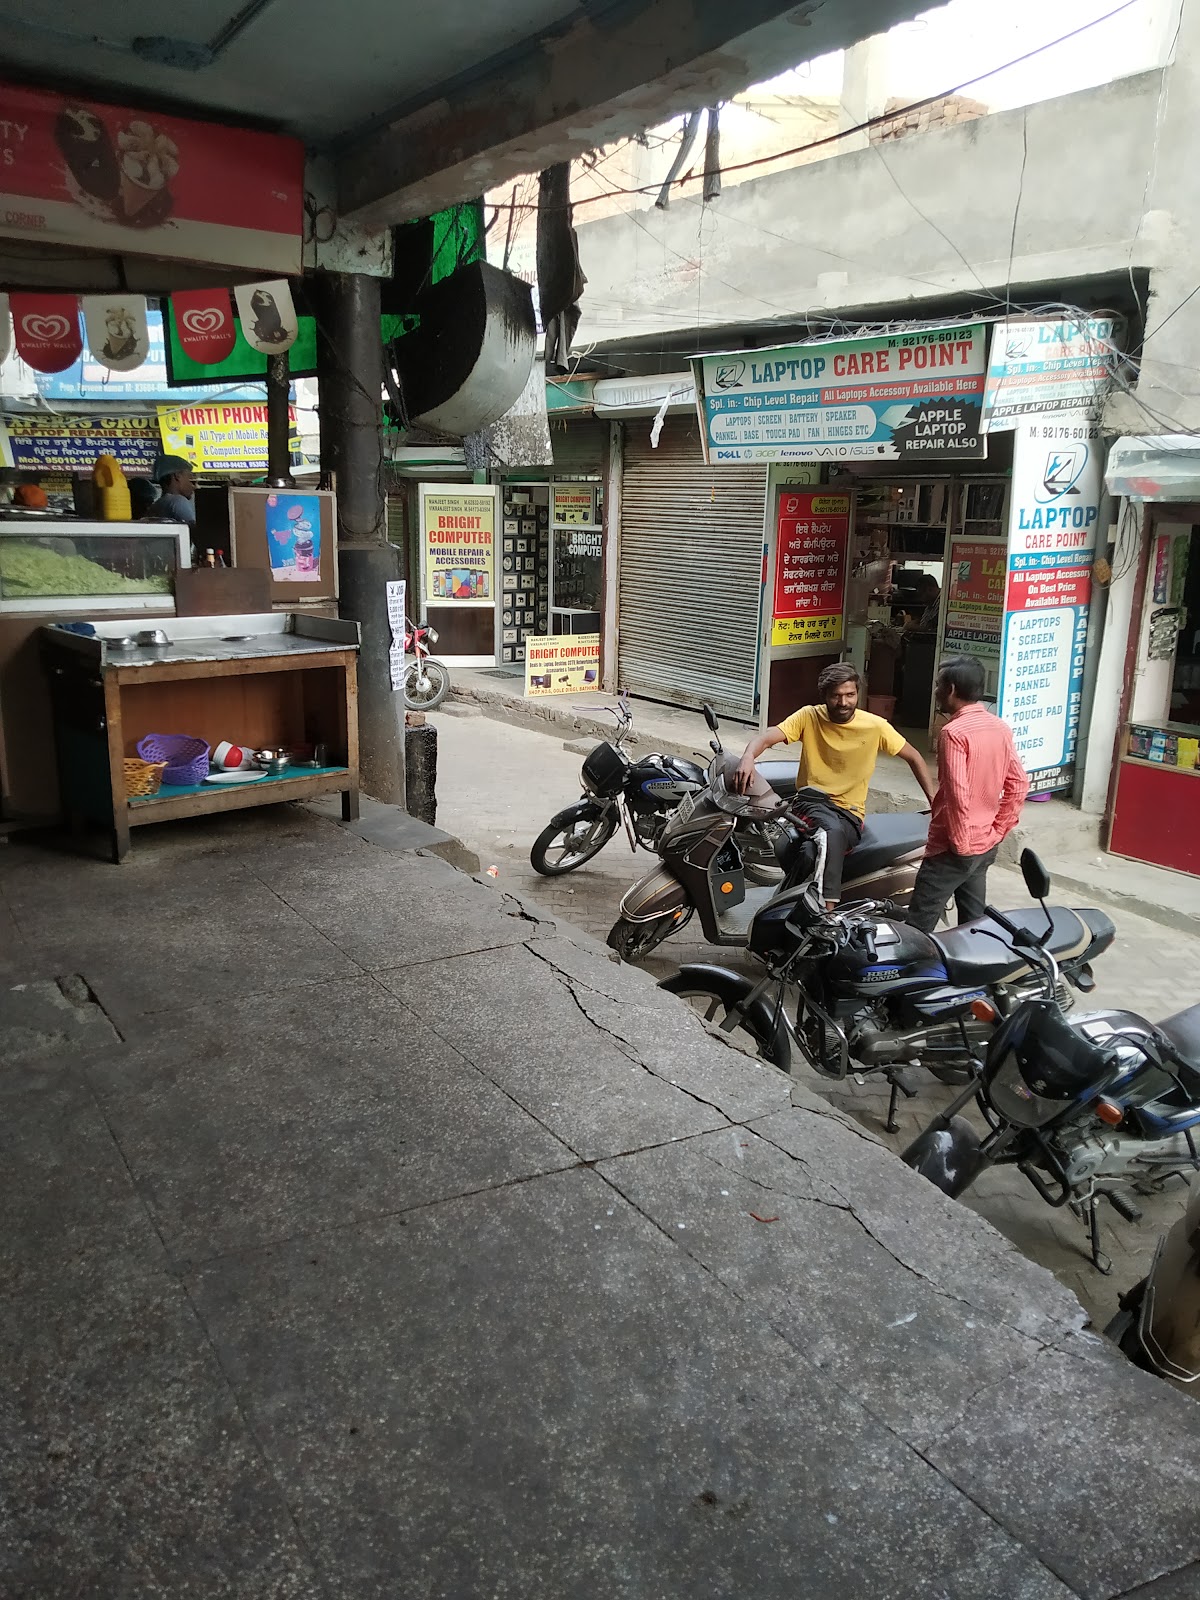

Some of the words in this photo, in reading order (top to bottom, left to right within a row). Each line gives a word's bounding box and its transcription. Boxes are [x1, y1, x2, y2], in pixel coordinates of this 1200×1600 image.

[183, 335, 209, 343] KWALITY
[211, 333, 231, 341] WALL'S
[902, 330, 972, 347] 92176-60123
[752, 357, 826, 383] LAPTOP
[833, 350, 889, 376] CARE
[899, 341, 972, 370] POINT
[1007, 365, 1023, 375] Spl.
[1043, 361, 1061, 371] Chip
[1064, 359, 1085, 369] Level
[996, 379, 1006, 387] All
[1009, 376, 1036, 386] Laptops
[1038, 372, 1070, 383] Accessory
[824, 389, 834, 400] All
[837, 386, 867, 401] Laptops
[870, 383, 910, 398] Accessory
[913, 381, 953, 394] Available
[956, 379, 977, 390] Here
[711, 399, 725, 410] Spl.
[743, 396, 762, 408] Chip
[765, 394, 787, 405] Level
[790, 392, 818, 404] Repair
[992, 404, 1023, 417] APPLE
[1024, 400, 1058, 412] LAPTOP
[1060, 396, 1091, 408] REPAIR
[180, 407, 219, 425] KIRTI
[726, 416, 751, 427] LAPTOPS
[758, 414, 781, 425] SCREEN
[789, 412, 818, 424] BATTERY
[825, 410, 856, 422] SPEAKER
[918, 408, 961, 423] APPLE
[69, 429, 117, 437] REPAIR
[716, 431, 737, 441] PANNEL
[744, 430, 759, 440] BASE
[766, 428, 786, 439] TOUCH
[788, 428, 800, 438] PAD
[808, 427, 820, 438] FAN
[828, 425, 854, 437] HINGES
[855, 424, 871, 435] ETC.
[915, 422, 966, 437] LAPTOP
[1042, 427, 1098, 439] 92176-60123
[200, 430, 209, 441] All
[210, 431, 225, 443] Type
[228, 431, 234, 440] of
[236, 430, 258, 440] Mobile
[906, 439, 944, 450] REPAIR
[946, 437, 977, 449] ALSO
[203, 446, 209, 455] &
[210, 446, 241, 458] Computer
[718, 451, 740, 459] DELL
[815, 447, 847, 456] VAIO
[438, 515, 481, 529] BRIGHT
[1018, 506, 1098, 529] LAPTOP
[429, 530, 492, 544] COMPUTER
[572, 533, 602, 545] BRIGHT
[789, 538, 801, 549] ਅਤੇ
[1026, 534, 1053, 549] CARE
[1056, 532, 1087, 547] POINT
[430, 548, 457, 556] MOBILE
[459, 548, 484, 557] REPAIR
[783, 553, 790, 564] ਦੇ
[827, 551, 839, 562] ਅਤੇ
[435, 557, 486, 566] ACCESSORIES
[1014, 556, 1027, 568] Spl.
[1041, 555, 1056, 567] Chip
[1057, 554, 1073, 564] Level
[1074, 553, 1093, 565] Repair
[817, 569, 825, 578] ਦਾ
[1013, 573, 1024, 583] All
[1025, 571, 1055, 583] Laptops
[1056, 569, 1091, 580] Accessory
[1028, 585, 1038, 594] On
[1040, 584, 1056, 593] Best
[1058, 582, 1076, 592] Price
[957, 590, 970, 600] Spl.
[987, 593, 1005, 603] Chip
[1025, 596, 1059, 608] Available
[1060, 595, 1077, 604] Here
[959, 602, 982, 611] Laptops
[807, 620, 816, 628] ਹਰ
[831, 616, 837, 626] ਦੇ
[1020, 617, 1061, 630] LAPTOPS
[947, 629, 972, 640] APPLE
[1018, 632, 1055, 646] SCREEN
[945, 641, 961, 650] DELL
[530, 648, 559, 660] BRIGHT
[560, 646, 600, 658] COMPUTER
[1017, 647, 1059, 661] BATTERY
[1016, 662, 1057, 676] SPEAKER
[1014, 678, 1050, 692] PANNEL
[1014, 694, 1037, 707] BASE
[1013, 708, 1043, 722] TOUCH
[1045, 705, 1063, 718] PAD
[1012, 725, 1029, 737] FAN
[1034, 767, 1061, 780] LAPTOP
[1037, 778, 1056, 791] HERE
[861, 973, 900, 982] HONDA
[866, 968, 898, 977] HERO
